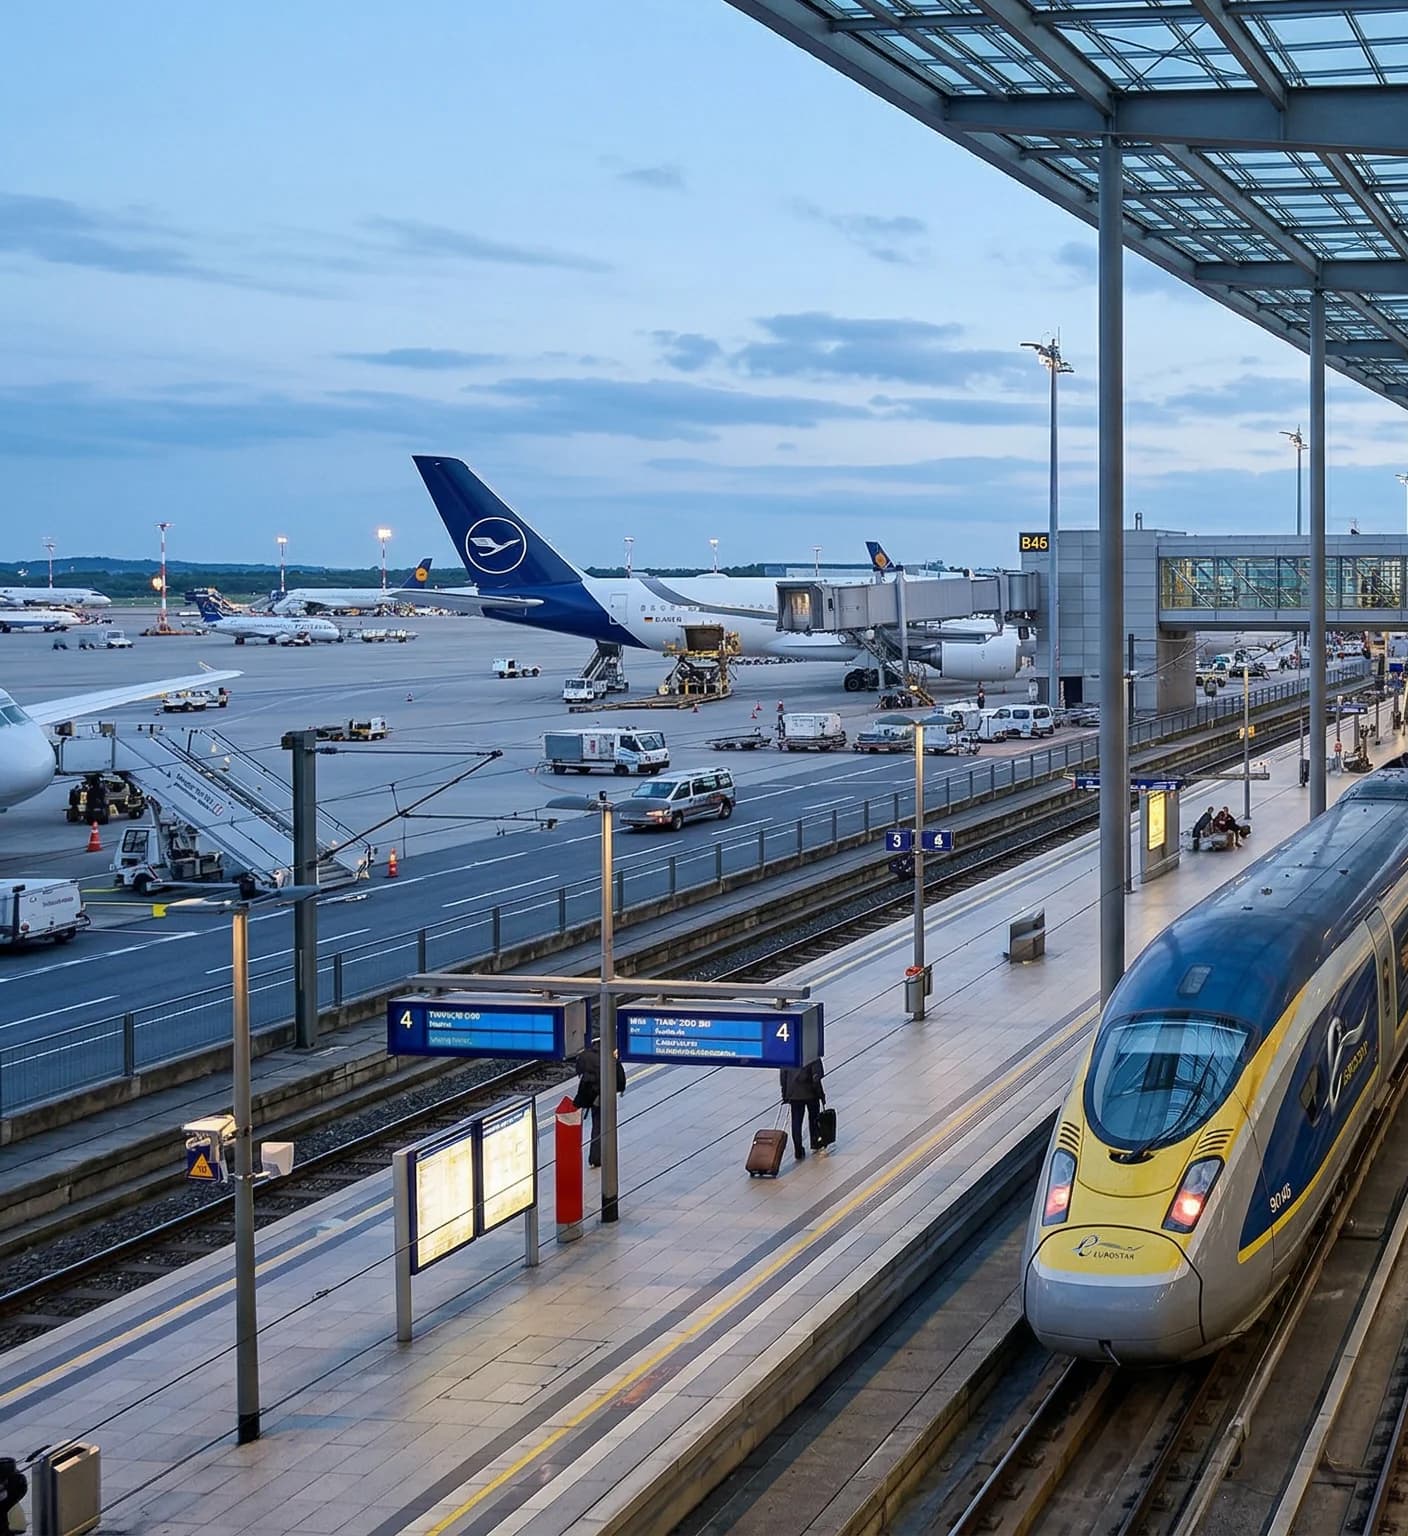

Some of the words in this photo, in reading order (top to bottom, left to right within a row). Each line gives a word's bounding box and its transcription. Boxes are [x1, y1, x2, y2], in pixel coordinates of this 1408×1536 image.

[892, 834, 902, 848] 3
[400, 1010, 413, 1029] 4
[775, 1022, 790, 1042] 4
